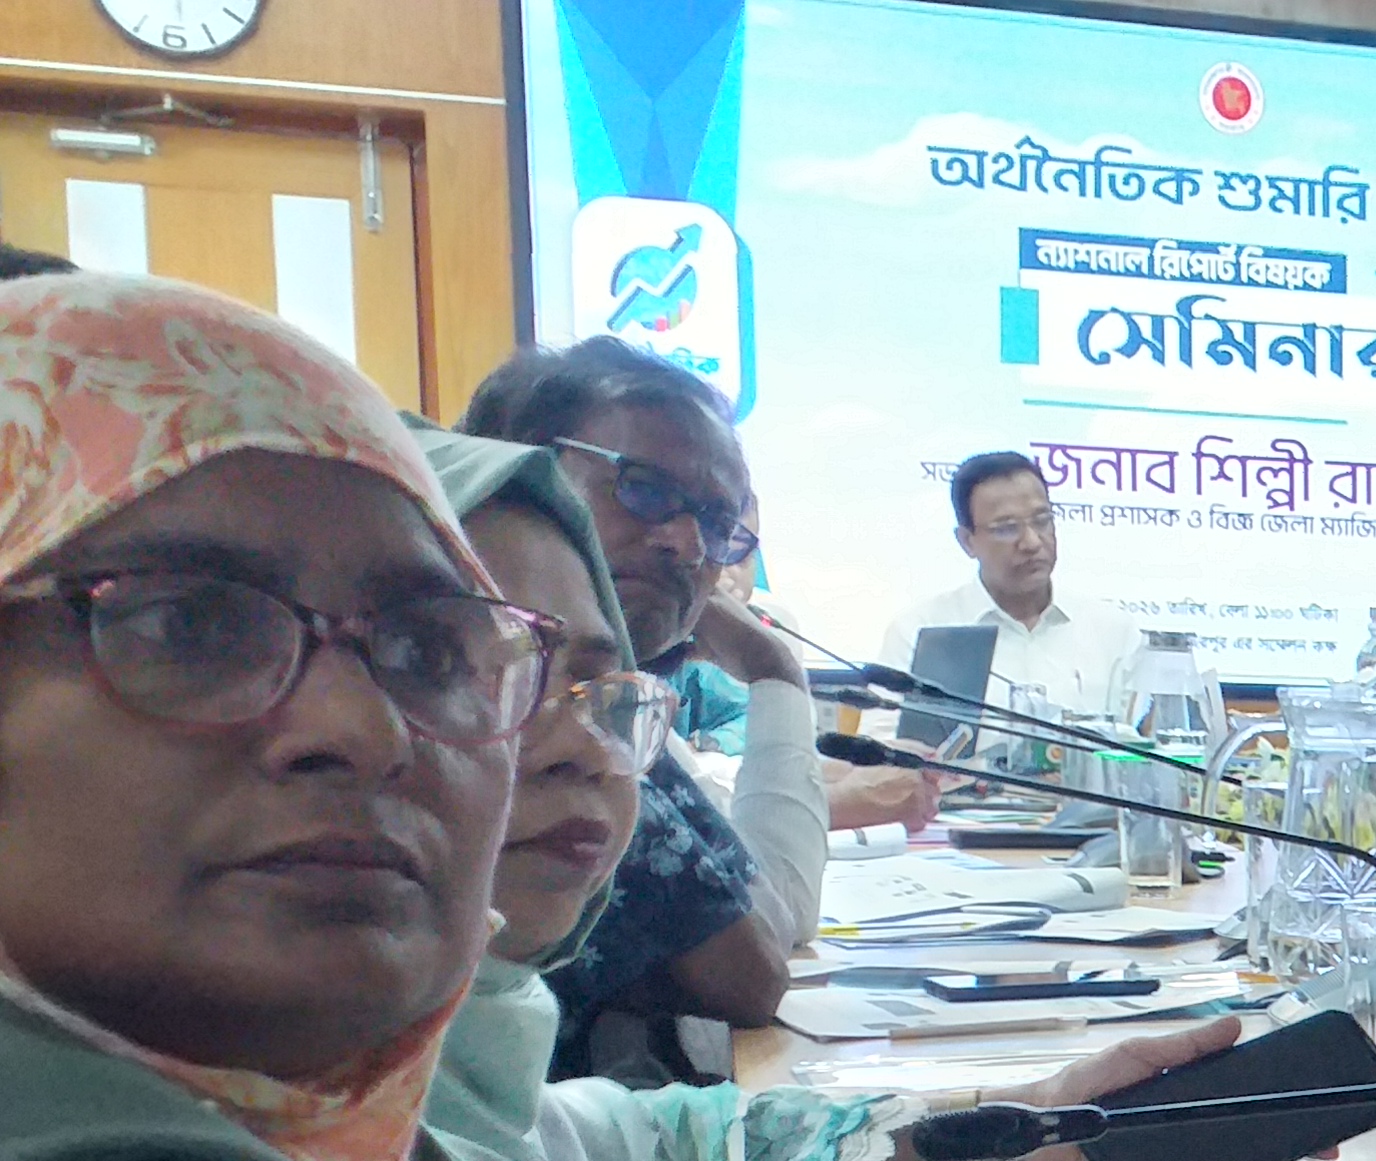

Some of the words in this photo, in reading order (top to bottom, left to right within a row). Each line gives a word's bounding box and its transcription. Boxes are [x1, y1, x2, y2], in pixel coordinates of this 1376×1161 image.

[162, 25, 187, 49] 6
[926, 135, 1203, 206] অর্থনৈতিক
[1213, 165, 1370, 225] শুমারি
[1035, 237, 1150, 276] ন্যাশনাল
[1153, 239, 1238, 282] রিপোর্ট
[1239, 247, 1332, 290] বিষয়ক
[1030, 441, 1179, 494] জনাব
[1192, 434, 1313, 512] শিল্পী
[1100, 504, 1180, 528] প্রশাসক
[1187, 509, 1202, 528] ও
[1260, 513, 1314, 533] জেলা
